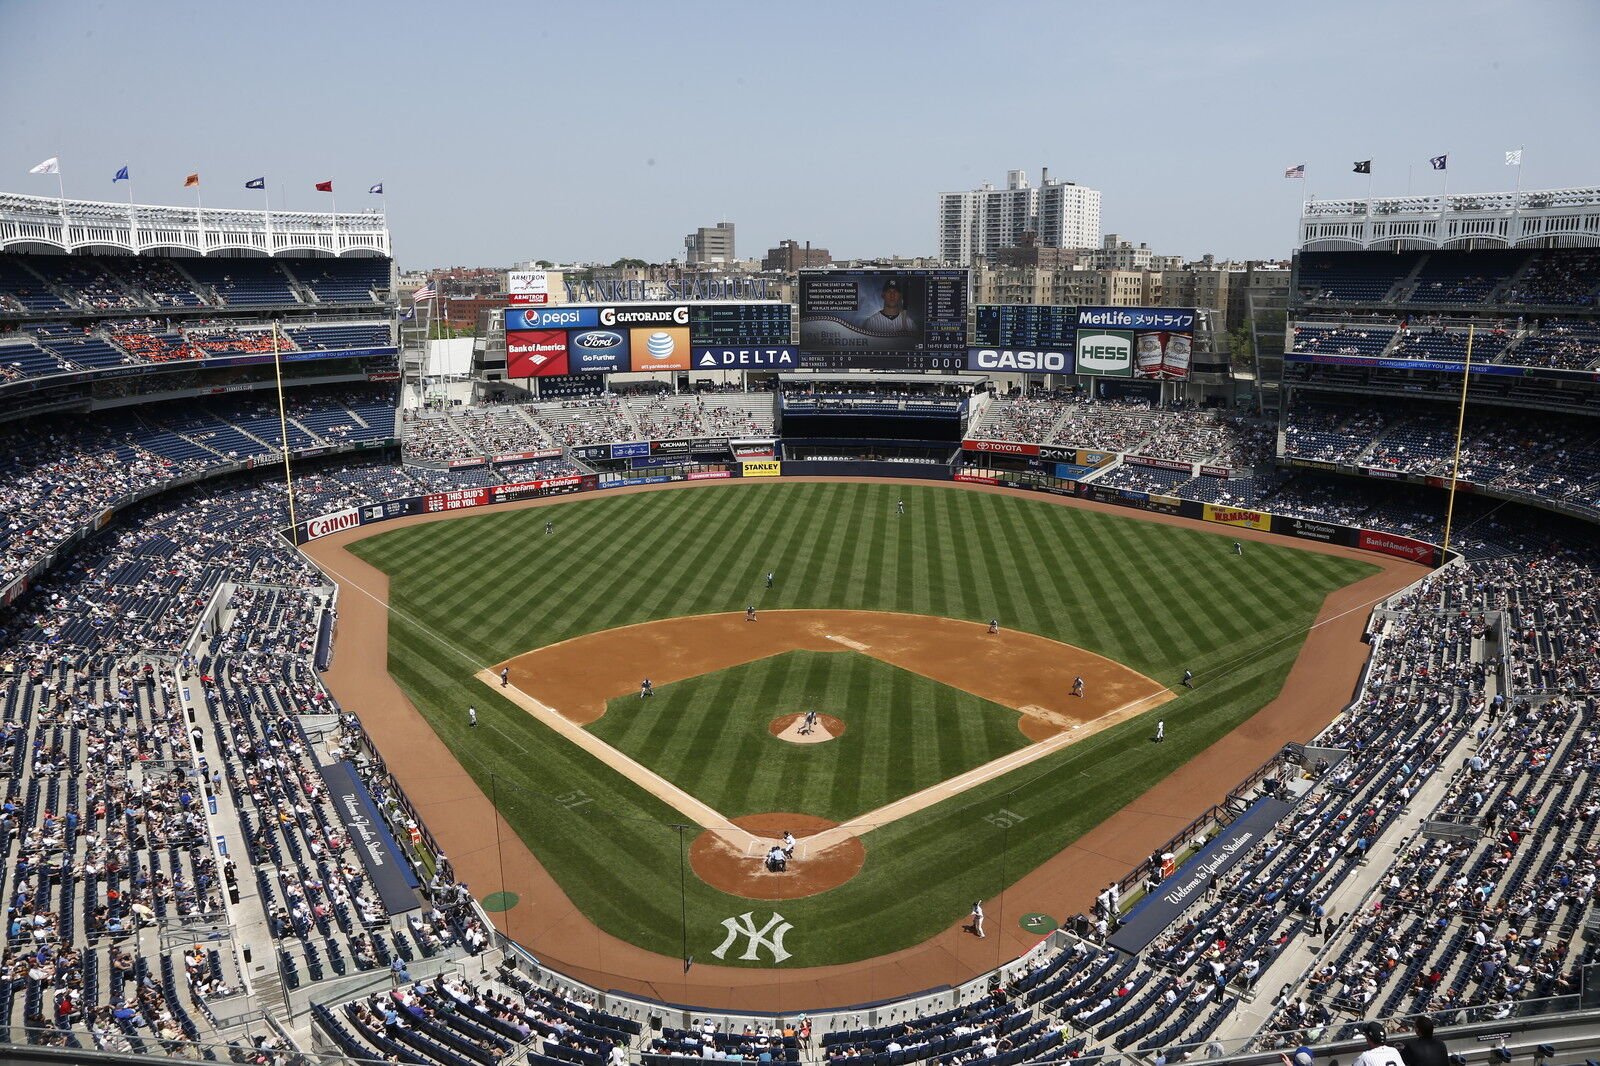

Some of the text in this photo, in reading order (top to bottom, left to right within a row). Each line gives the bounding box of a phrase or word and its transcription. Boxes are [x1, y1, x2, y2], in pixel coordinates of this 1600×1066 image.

[563, 278, 768, 301] YANKEE STADIUM
[542, 310, 580, 325] pepsi
[617, 312, 672, 322] GATORADE
[1079, 311, 1132, 325] MetLife
[1136, 314, 1193, 326] メットライフ
[536, 343, 565, 351] America
[584, 334, 613, 347] Ford
[820, 338, 868, 346] GARDNER
[723, 350, 792, 364] DELTA
[978, 350, 1064, 370] CASIO
[1082, 346, 1127, 360] HESS
[253, 455, 284, 463] SYRACUSE
[1040, 450, 1075, 460] DKNY
[446, 489, 483, 500] THIS BUD'S
[309, 512, 358, 537] Canon
[1305, 524, 1335, 534] PlayStation
[1367, 538, 1382, 547] Bank
[1390, 542, 1413, 553] America
[342, 793, 359, 816] Welcome
[348, 819, 376, 840] Yankee
[365, 841, 384, 866] Stadium
[1164, 877, 1202, 904] Welcome
[1198, 853, 1229, 875] Yankee
[711, 911, 794, 963] NY
